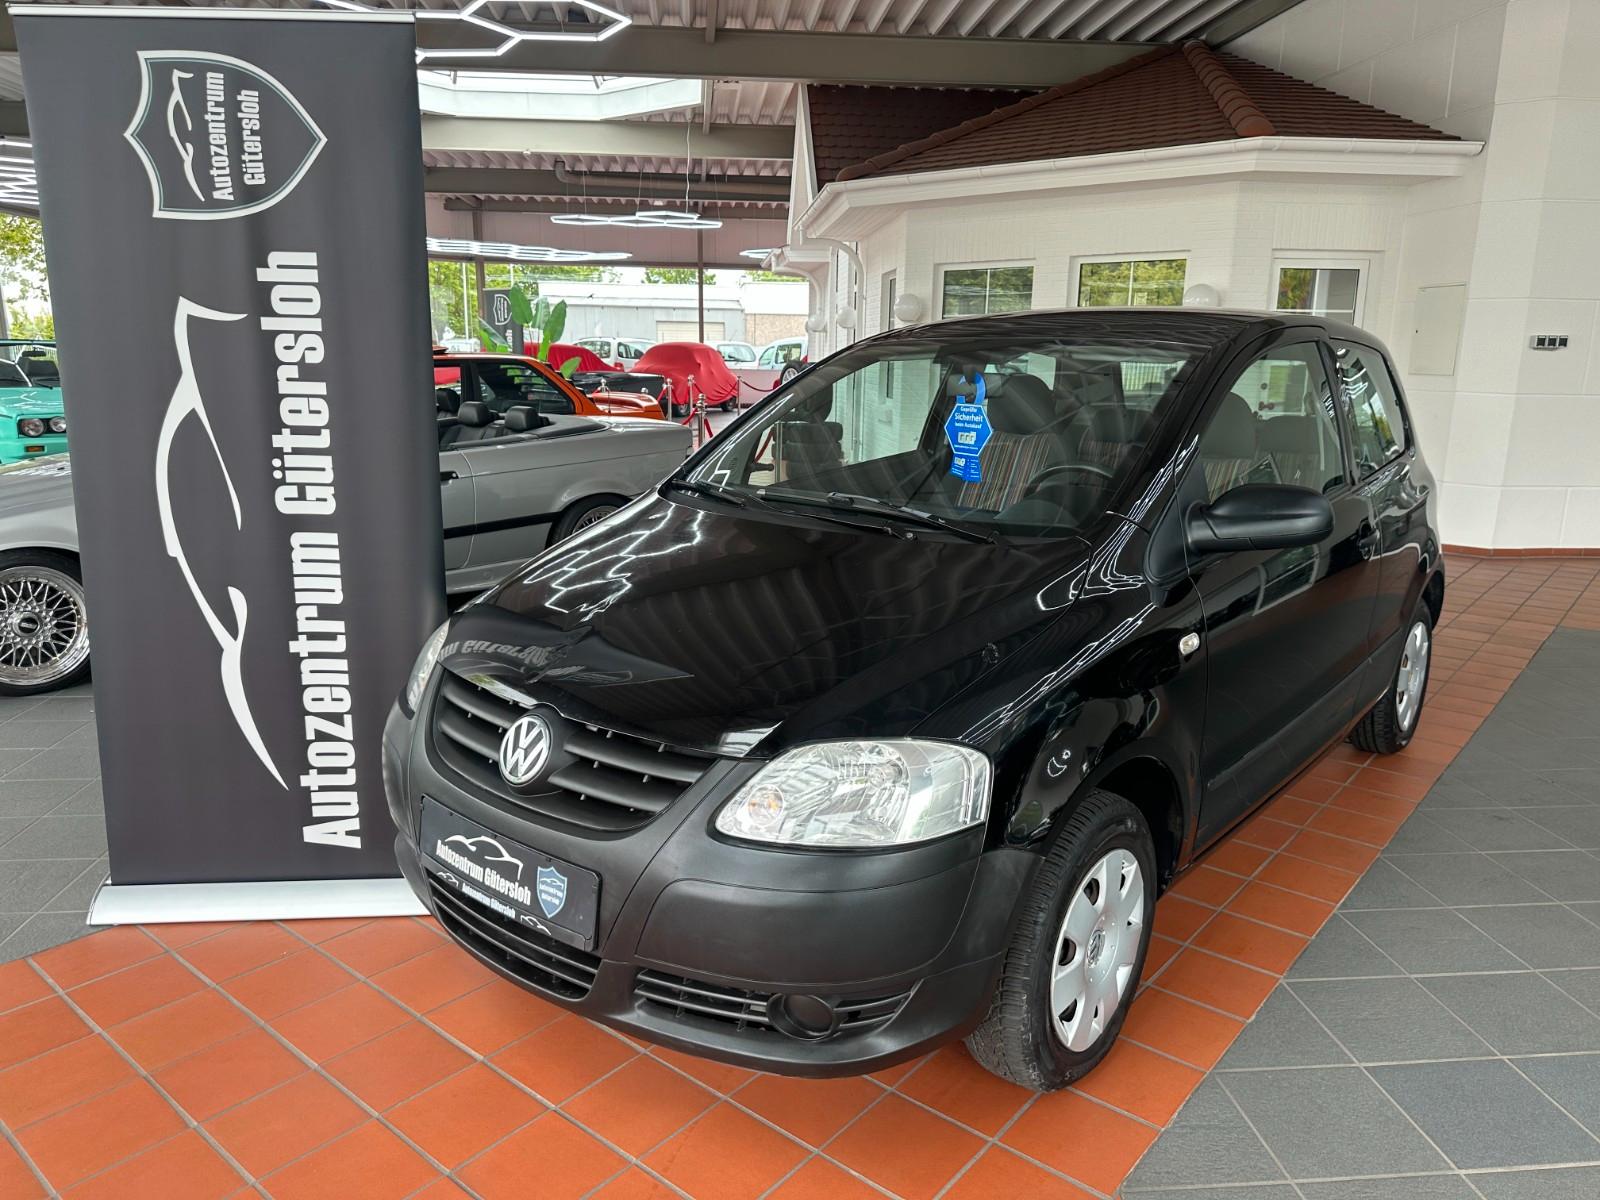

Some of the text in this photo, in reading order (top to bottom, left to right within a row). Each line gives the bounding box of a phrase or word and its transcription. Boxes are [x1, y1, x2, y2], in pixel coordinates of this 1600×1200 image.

[204, 71, 235, 201] Autozentrum
[236, 89, 266, 186] Gütersloh
[955, 413, 983, 422] Sicherheit
[256, 251, 362, 849] Autozentrum Gütersloh
[435, 839, 532, 907] Autozentrum Gütersloh
